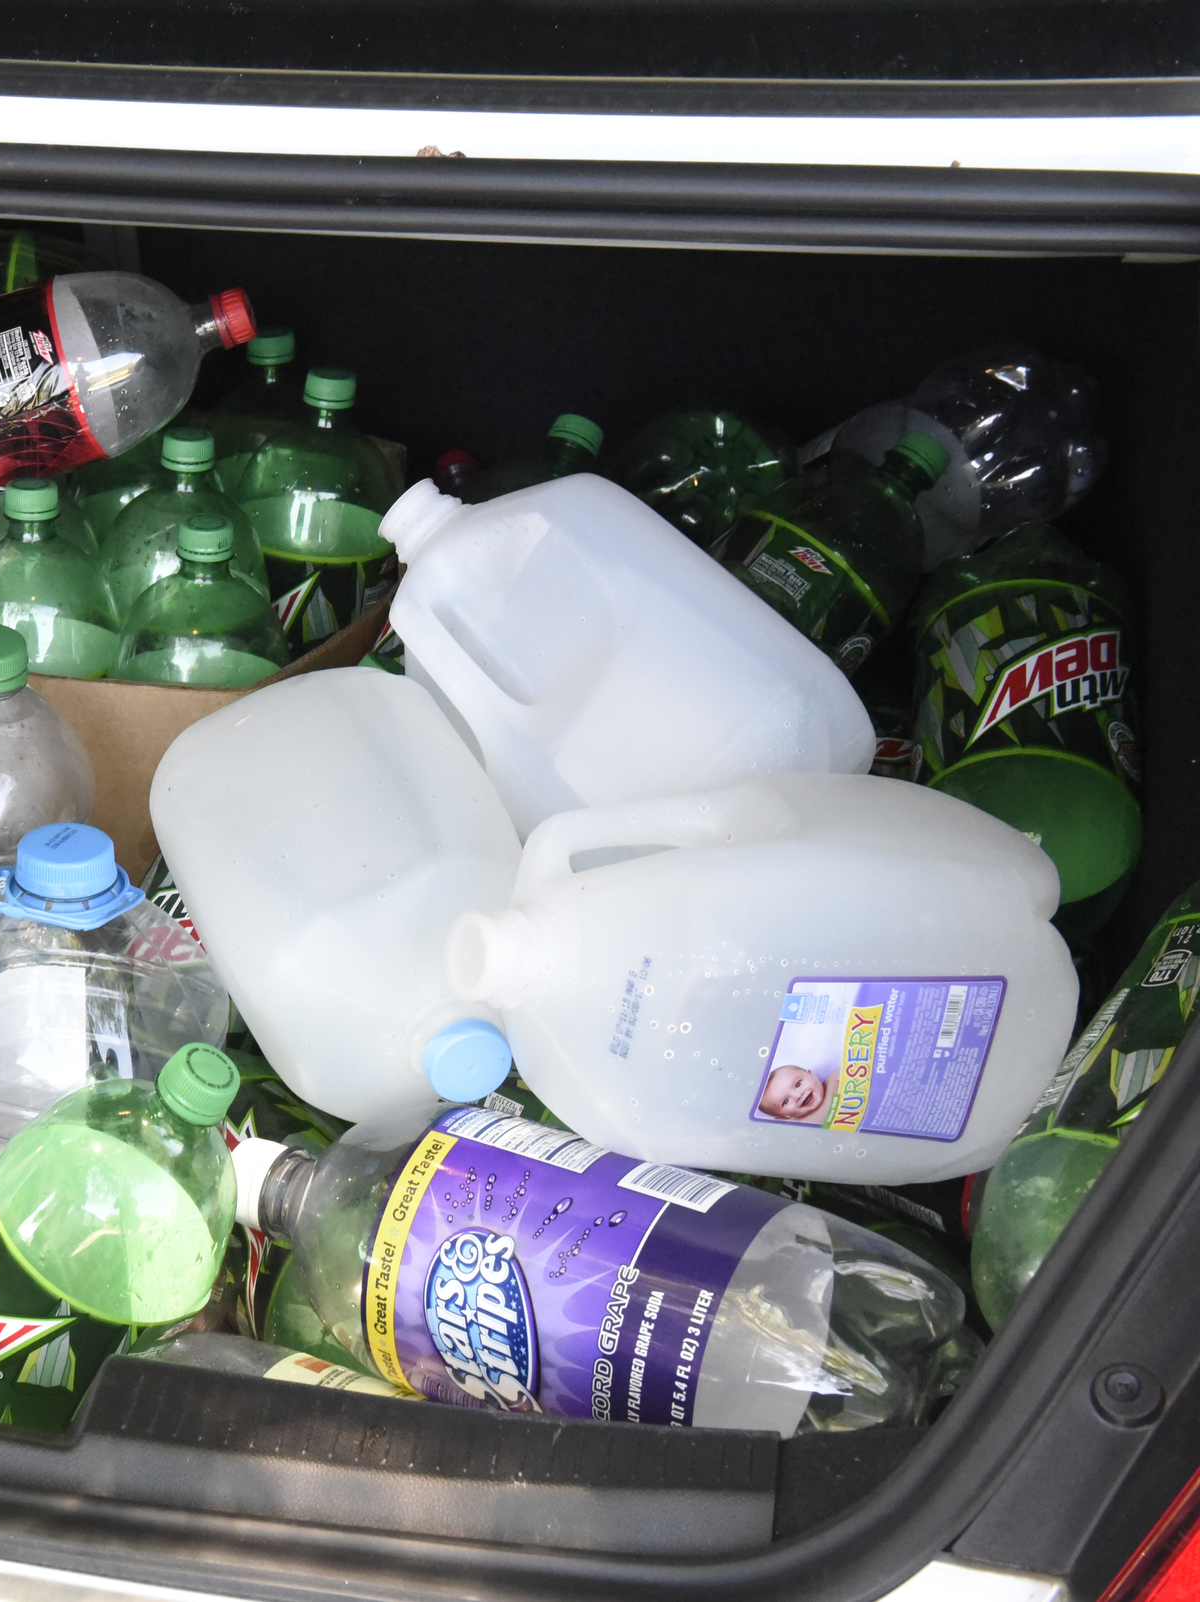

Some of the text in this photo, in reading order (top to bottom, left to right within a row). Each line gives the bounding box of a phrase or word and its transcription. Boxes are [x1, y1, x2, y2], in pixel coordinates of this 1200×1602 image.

[760, 555, 785, 574] Nutrition
[785, 571, 803, 586] Facts
[1149, 970, 1171, 982] 170
[795, 996, 806, 1019] steam
[876, 987, 899, 1072] purified water
[834, 1012, 874, 1124] NURSERY
[451, 1112, 479, 1132] Nutrition
[392, 1139, 446, 1222] Great Taste!
[374, 1241, 396, 1335] Great Taste!
[435, 1232, 511, 1411] Stars &
[598, 1265, 640, 1355] GRAPE
[644, 1291, 665, 1320] SODA
[691, 1289, 714, 1325] LITER
[474, 1233, 543, 1413] Stripes
[635, 1320, 655, 1357] GRAPE
[688, 1326, 701, 1336] 3
[679, 1338, 700, 1361] OZ)
[628, 1357, 646, 1410] FLAVORED
[676, 1365, 692, 1379] FL
[673, 1381, 688, 1401] 5.4
[671, 1402, 685, 1420] QT
